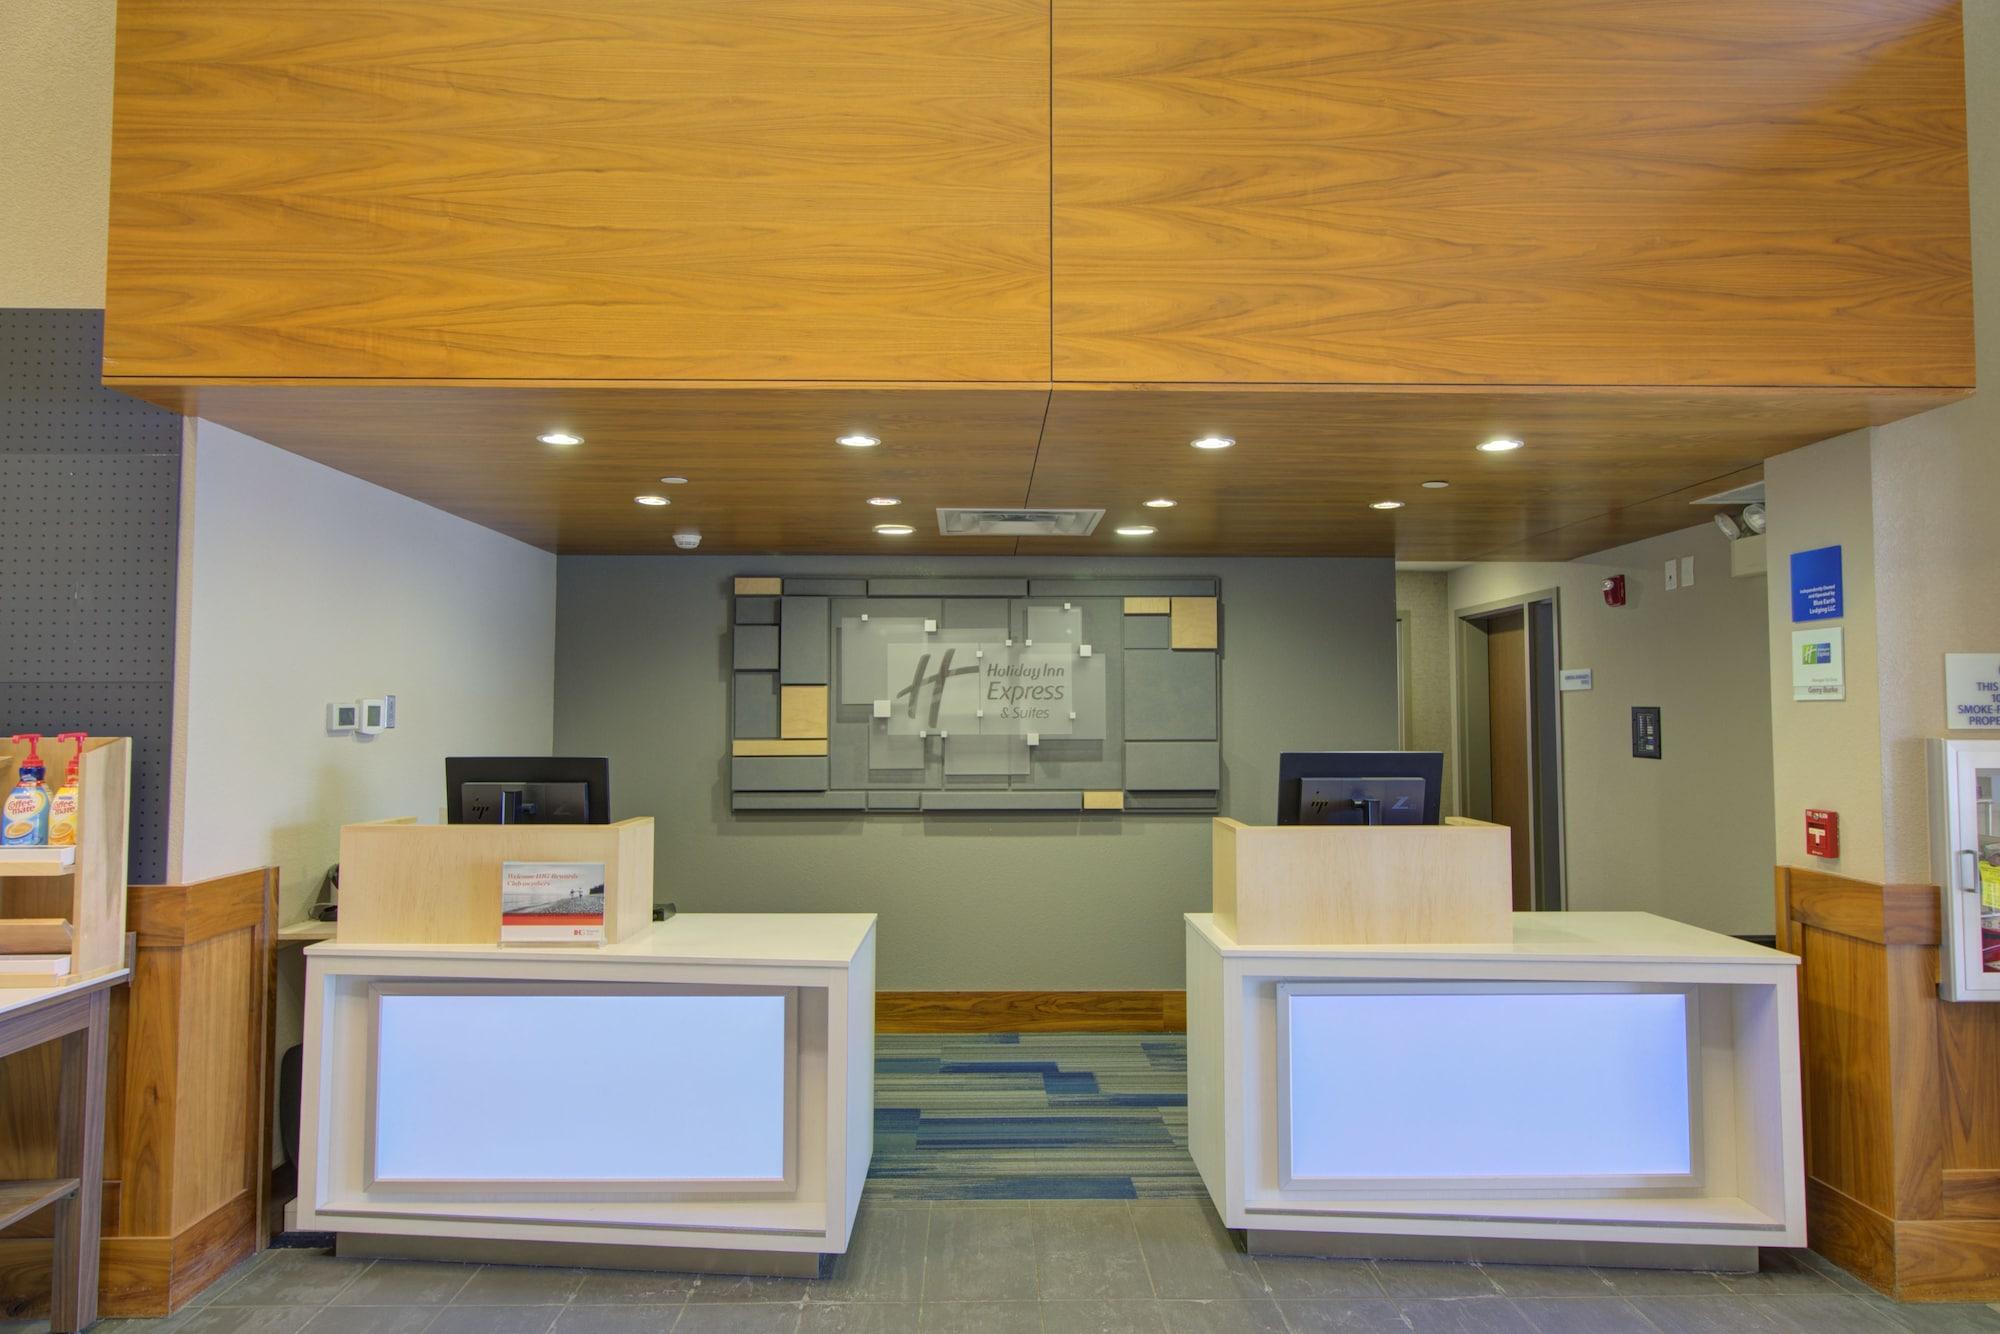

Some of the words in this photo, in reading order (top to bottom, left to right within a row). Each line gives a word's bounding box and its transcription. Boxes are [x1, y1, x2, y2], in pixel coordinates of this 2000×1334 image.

[987, 663, 1041, 680] Holiday
[1043, 663, 1065, 677] Inn
[987, 681, 1065, 705] Express
[1976, 681, 1999, 691] THIS
[1001, 707, 1010, 719] &
[1012, 706, 1050, 719] Suites
